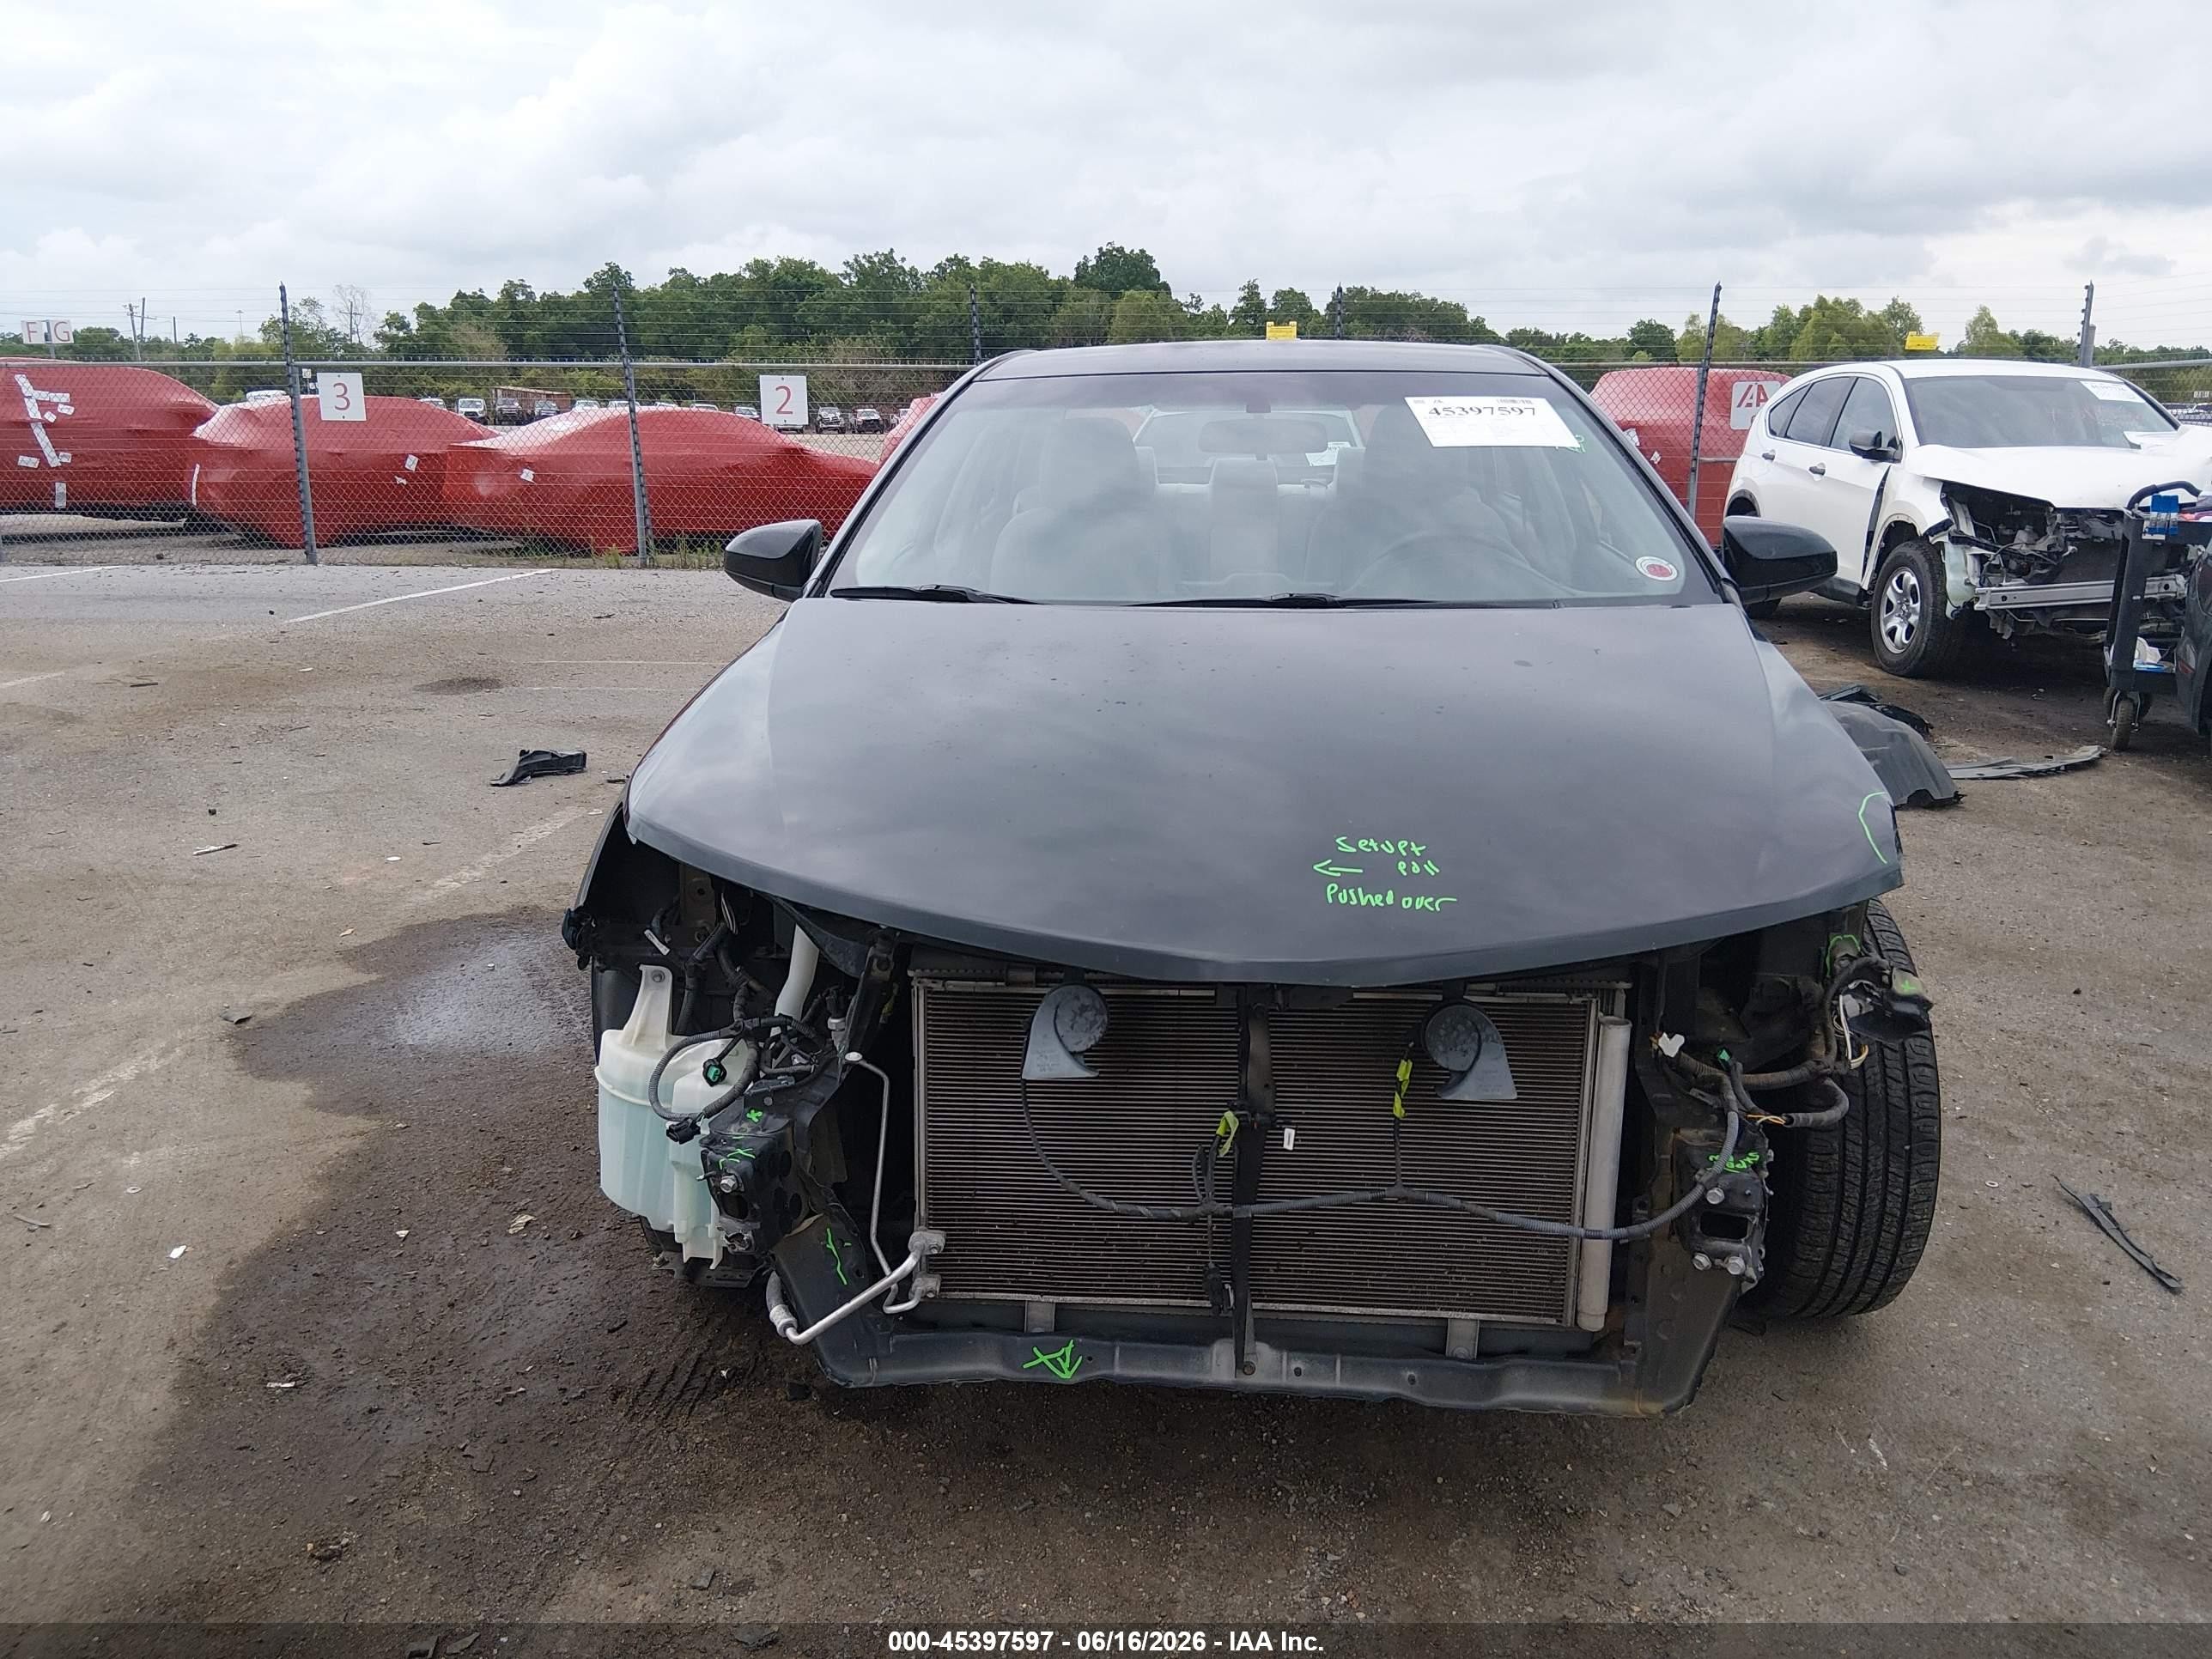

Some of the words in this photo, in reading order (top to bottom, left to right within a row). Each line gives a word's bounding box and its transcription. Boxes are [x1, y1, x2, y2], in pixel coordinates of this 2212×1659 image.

[26, 321, 37, 343] F
[53, 321, 70, 342] G
[332, 382, 350, 410] 3
[775, 385, 793, 414] 2
[1428, 406, 1535, 416] 45397597
